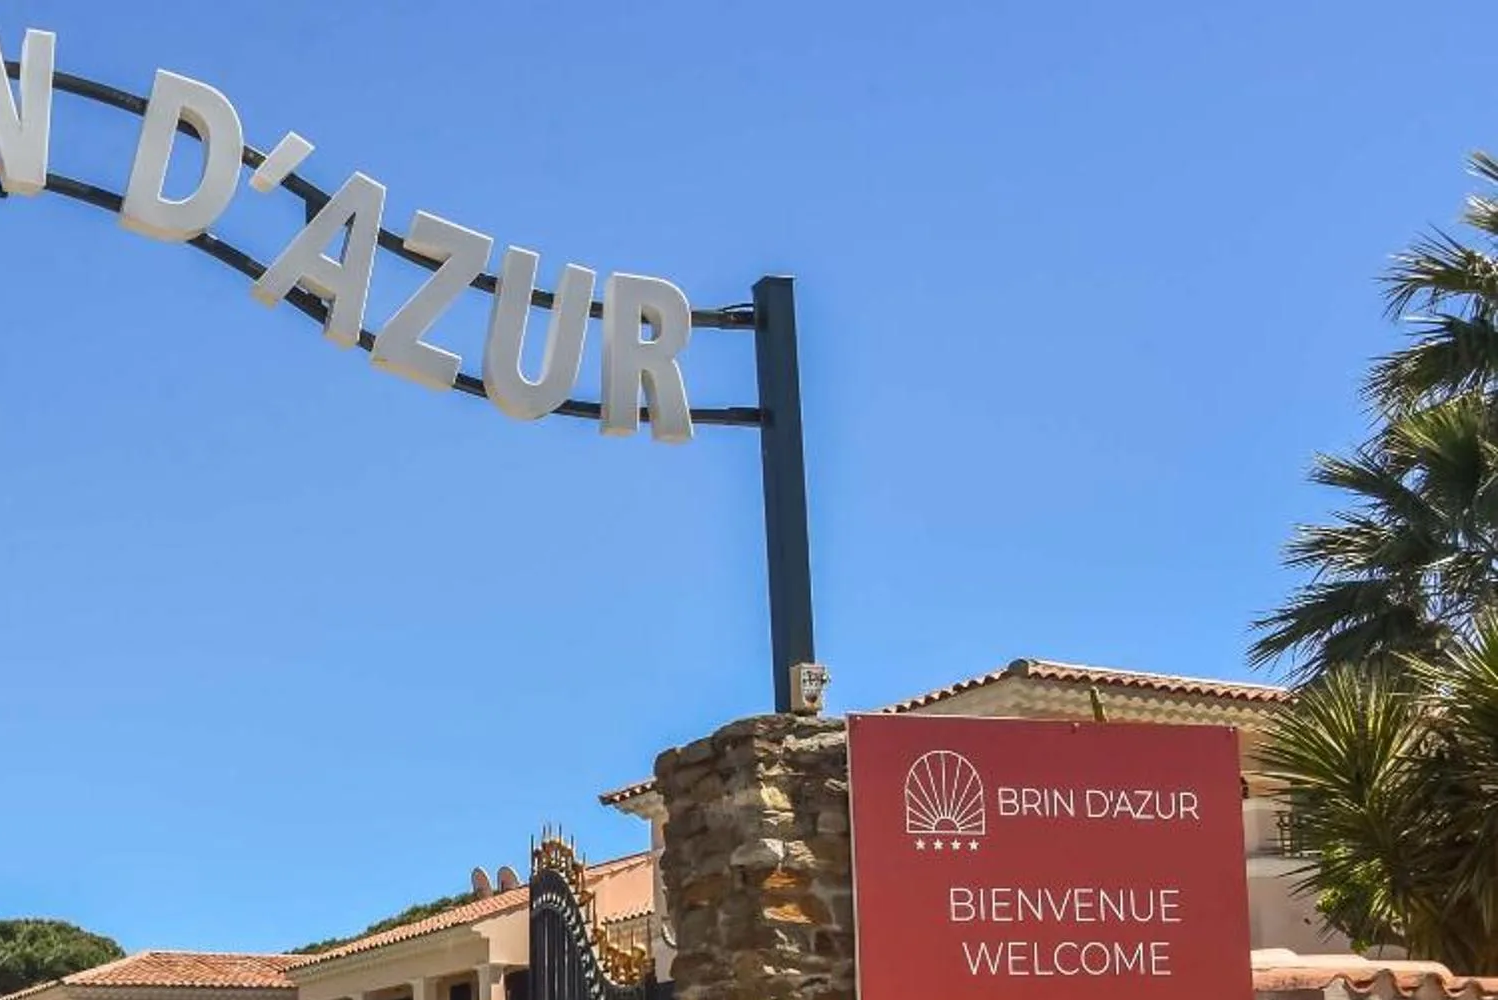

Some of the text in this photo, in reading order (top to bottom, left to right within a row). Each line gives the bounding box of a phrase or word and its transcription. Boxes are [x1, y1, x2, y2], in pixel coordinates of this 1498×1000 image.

[117, 68, 696, 446] D'AZUR
[997, 787, 1200, 820] BRIN D'AZUR
[949, 887, 1183, 923] BIENVENUE
[961, 941, 1173, 976] WELCOME
